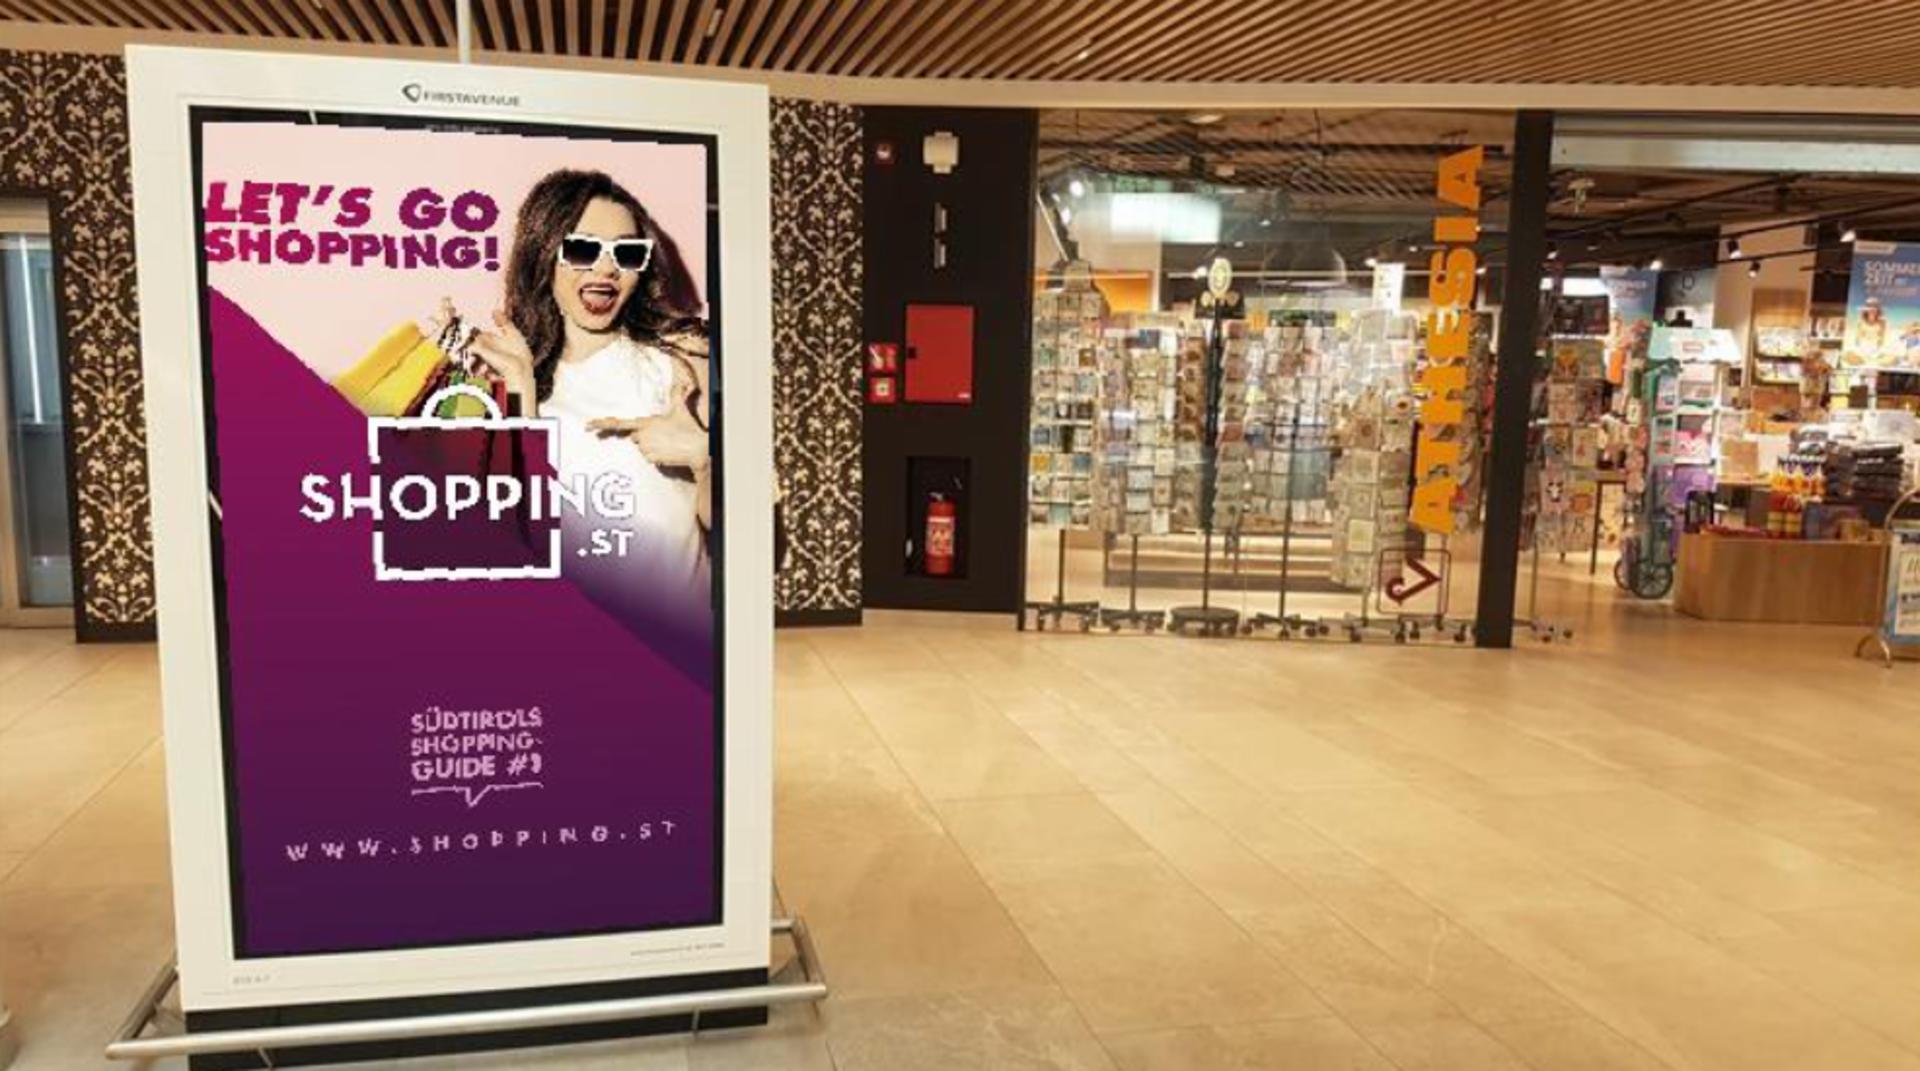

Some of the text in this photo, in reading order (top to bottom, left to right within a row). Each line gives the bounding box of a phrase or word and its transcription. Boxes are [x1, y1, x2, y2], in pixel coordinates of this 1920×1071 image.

[423, 91, 520, 106] FIRSTAVENUE
[204, 180, 500, 232] LET'S GO
[205, 228, 500, 272] SHOPPING!
[1865, 261, 1920, 276] SOMME
[1409, 145, 1484, 534] ATHESIA
[299, 471, 636, 523] SHOPPING
[577, 528, 634, 557] .ST
[411, 706, 543, 734] SÜDTIROLS
[411, 755, 496, 781] GUIDE
